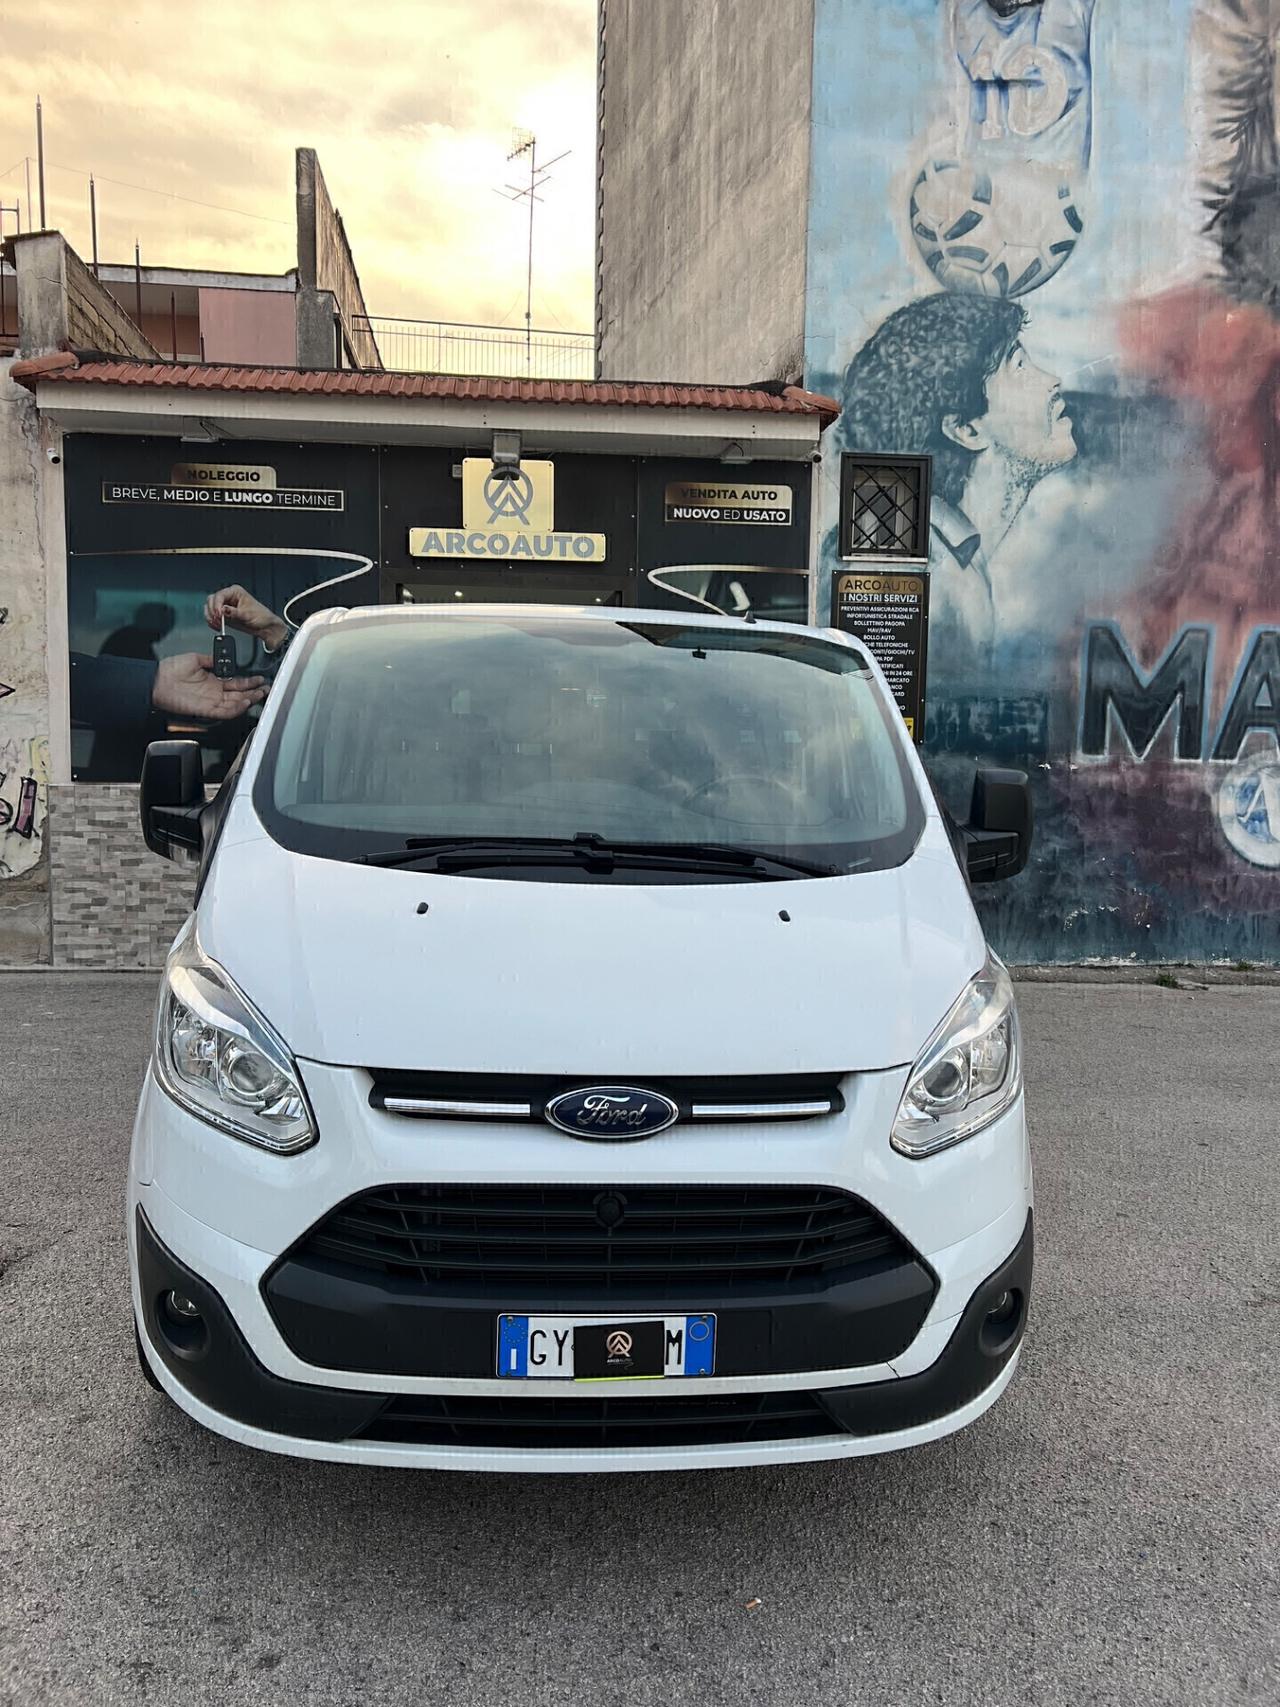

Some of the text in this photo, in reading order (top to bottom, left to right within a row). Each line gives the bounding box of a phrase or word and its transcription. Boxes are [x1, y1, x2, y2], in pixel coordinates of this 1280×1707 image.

[187, 469, 261, 483] NOLEGGIO
[112, 487, 336, 507] BREVE, MEDIO E LUNGO TERMINE
[681, 488, 778, 501] VENDITA AUTO
[673, 507, 787, 522] NUOVO ED USATO
[421, 531, 595, 558] ARCOAUTO
[844, 579, 919, 592] ARCOAUTO
[848, 593, 882, 602] NOSTRI
[884, 594, 918, 603] SERVIZI
[577, 1095, 648, 1125] Ford
[530, 1329, 569, 1366] GY
[665, 1329, 683, 1366] M
